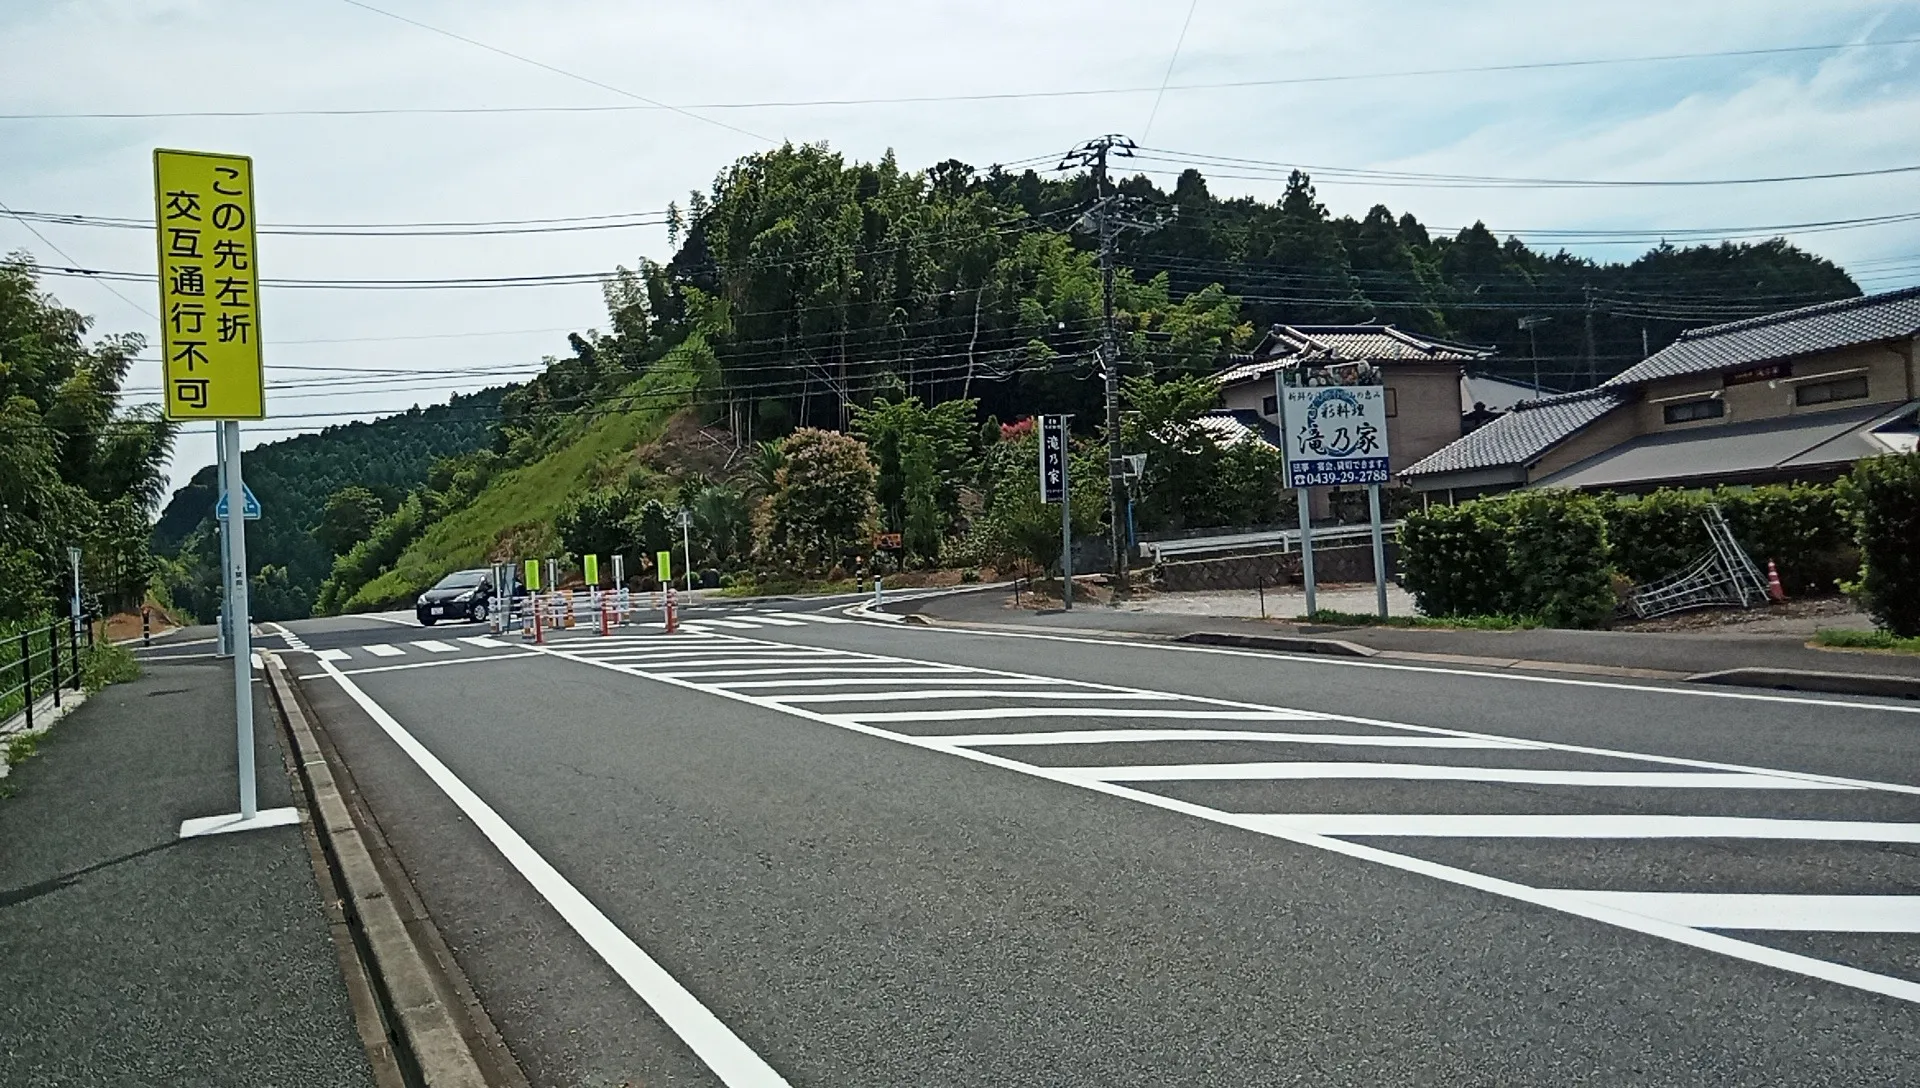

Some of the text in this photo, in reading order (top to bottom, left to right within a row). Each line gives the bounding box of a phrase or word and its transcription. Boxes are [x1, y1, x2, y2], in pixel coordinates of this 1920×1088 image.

[165, 190, 211, 409] 交互通行不可
[212, 166, 251, 344] この先左折
[1297, 422, 1380, 455] 滝乃家
[1306, 470, 1388, 485] 0439-29-2788
